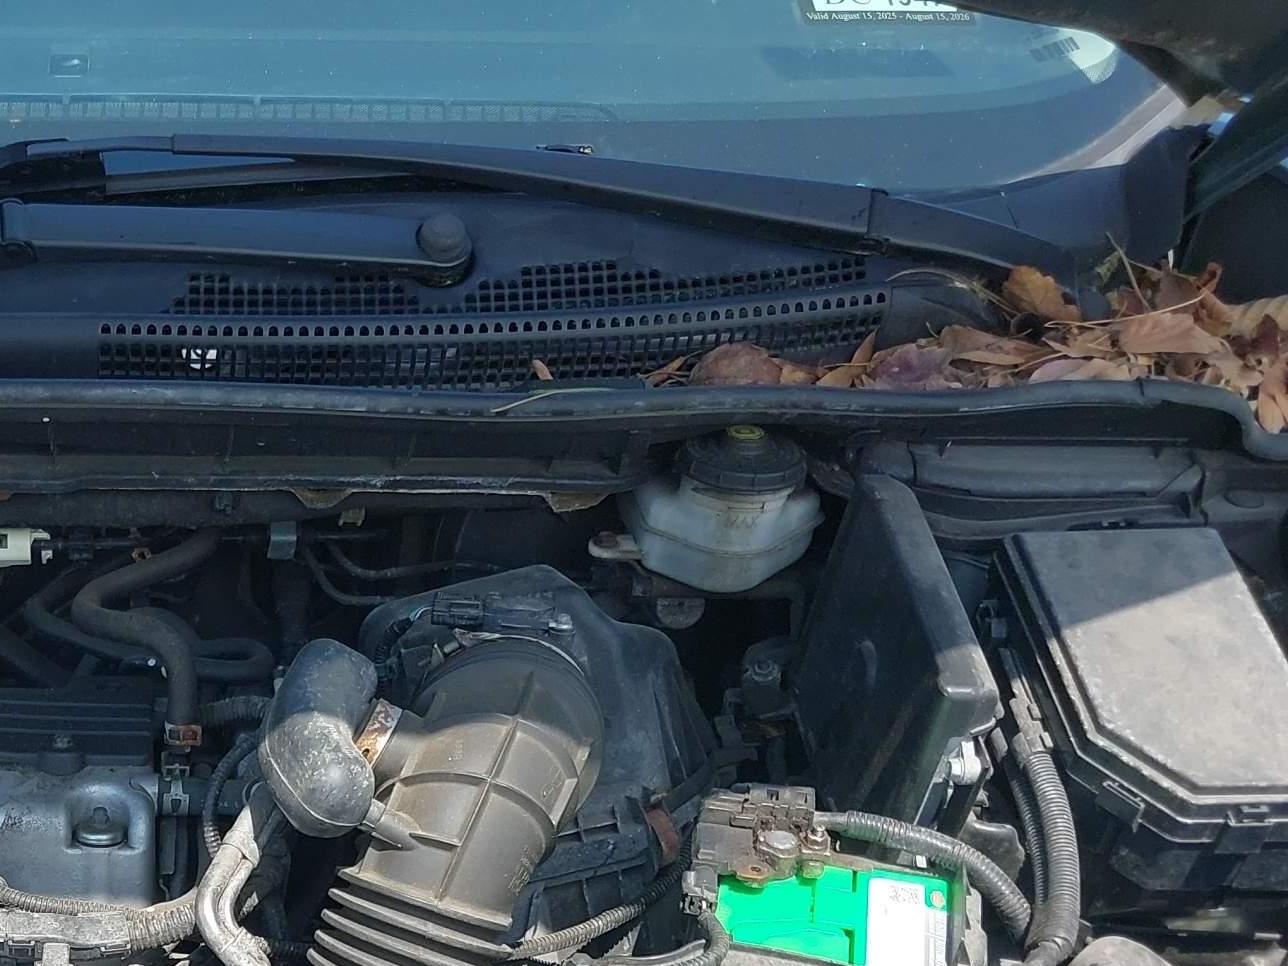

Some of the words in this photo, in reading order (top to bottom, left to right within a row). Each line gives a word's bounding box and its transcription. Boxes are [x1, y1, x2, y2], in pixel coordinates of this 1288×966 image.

[806, 12, 829, 20] Valid
[831, 12, 860, 21] August
[862, 12, 875, 20] 15,
[876, 12, 897, 20] 2025
[905, 12, 934, 22] August
[935, 12, 949, 21] 15,
[949, 13, 970, 21] 2026
